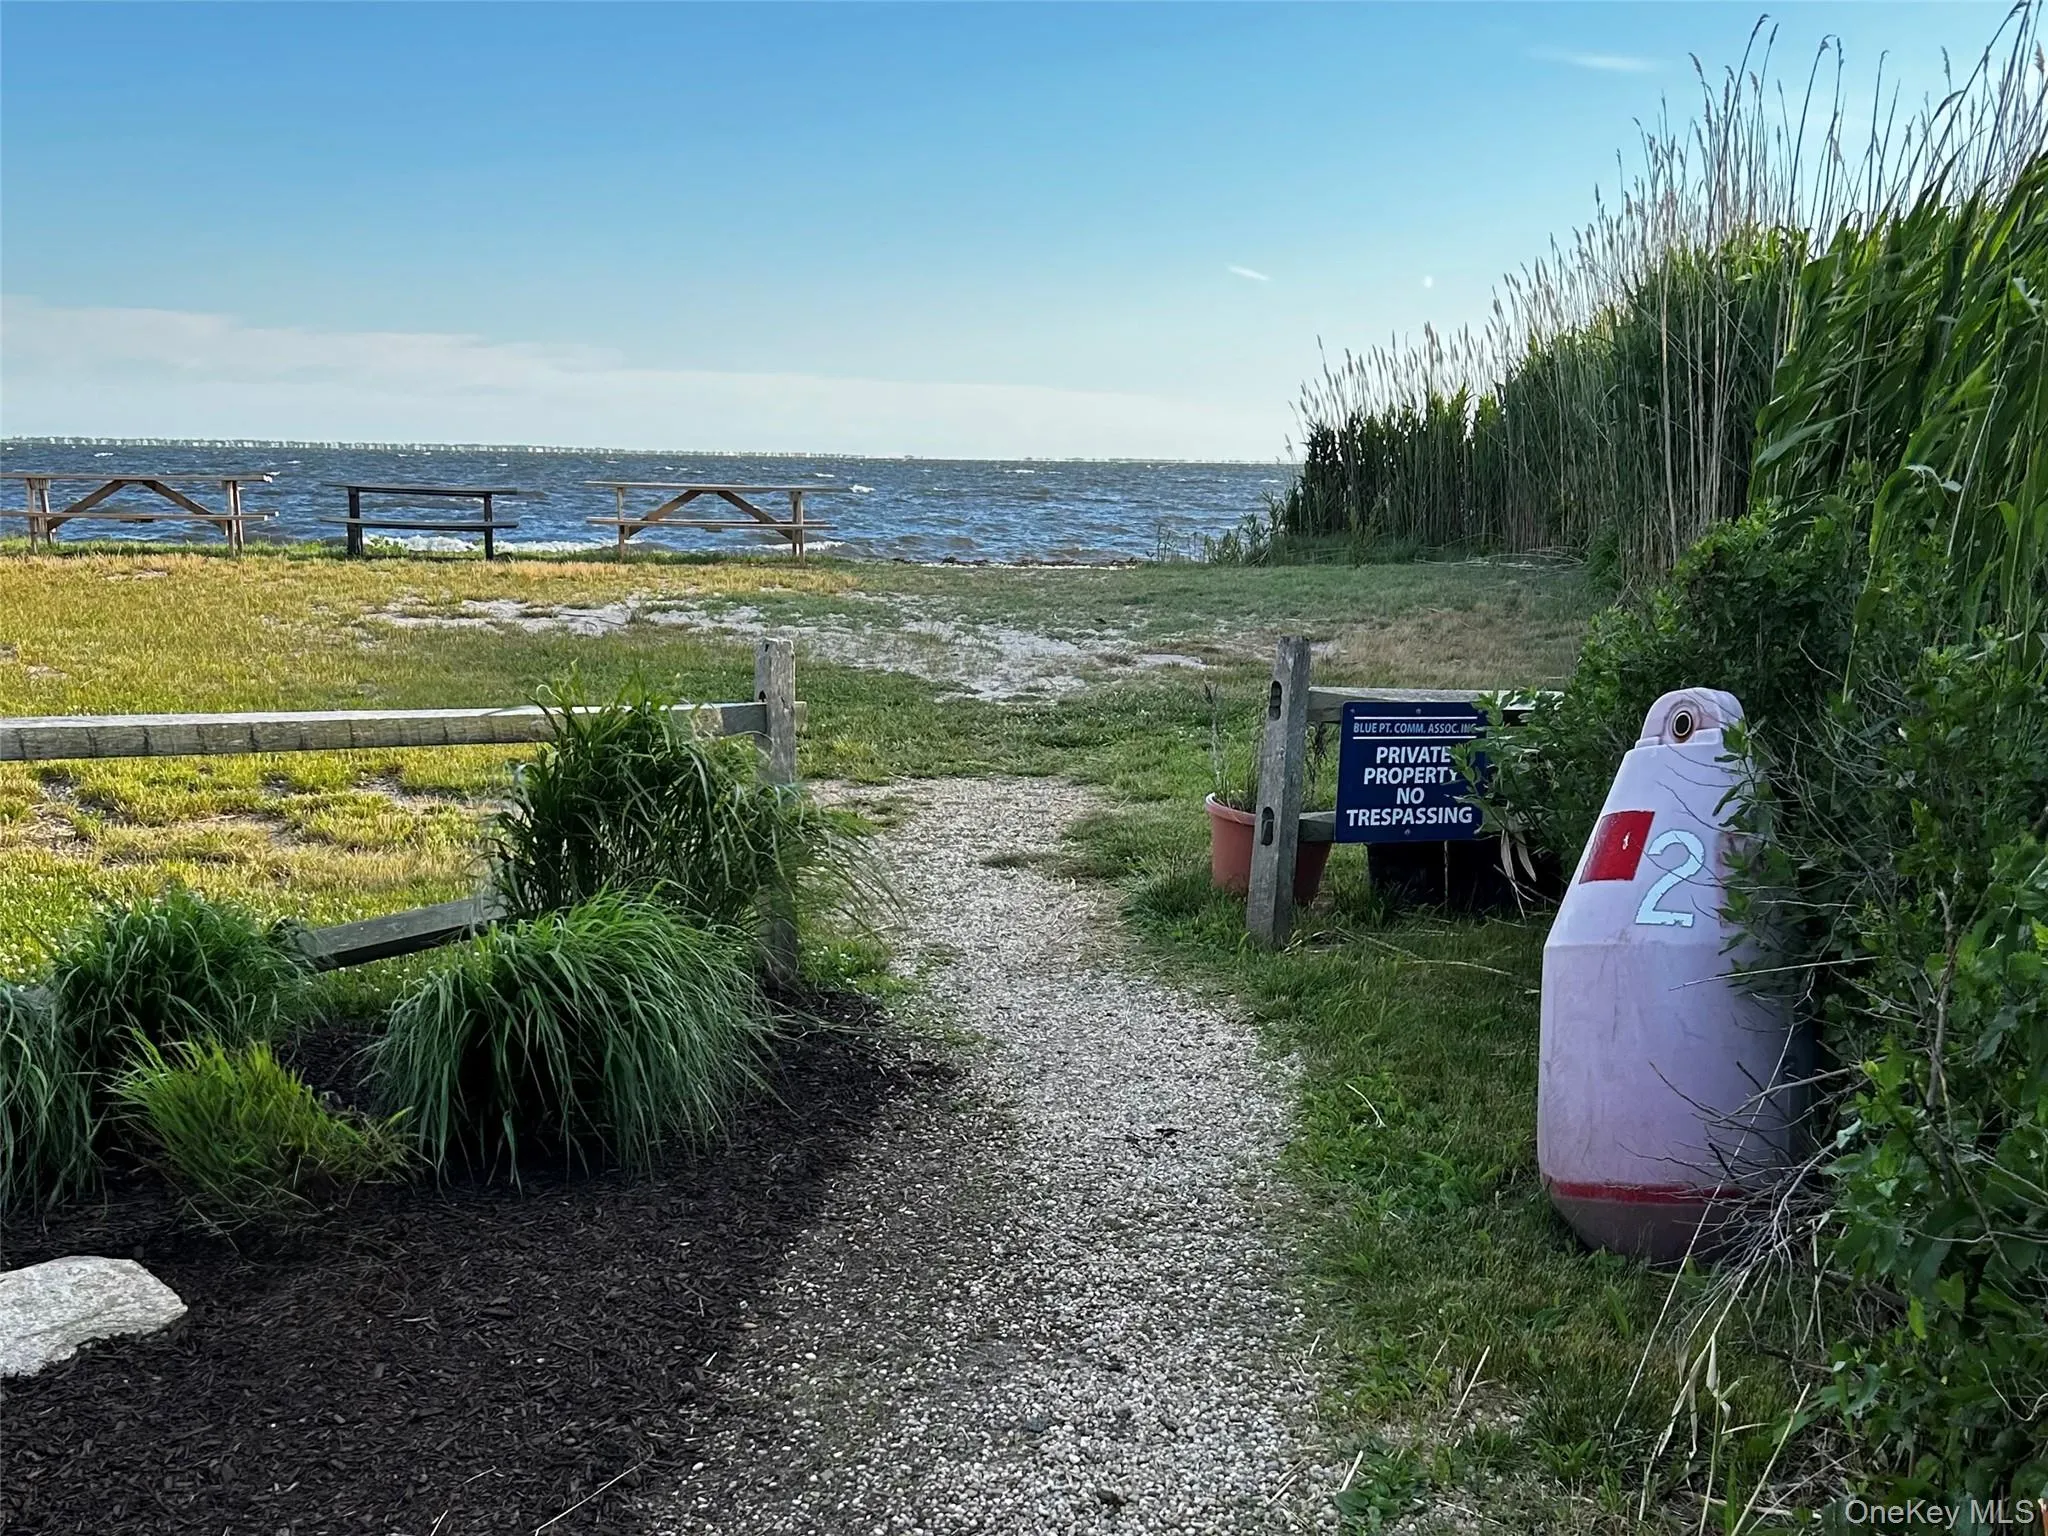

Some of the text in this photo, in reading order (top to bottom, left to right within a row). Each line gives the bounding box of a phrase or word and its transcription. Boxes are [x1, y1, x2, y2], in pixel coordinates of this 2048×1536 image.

[1353, 722, 1377, 734] BLUE
[1379, 723, 1393, 734] PT.
[1394, 723, 1426, 734] COMM.
[1428, 723, 1460, 734] ASSOC.
[1376, 746, 1451, 764] PRIVATE
[1363, 767, 1458, 785] PROPERTY
[1396, 787, 1425, 805] NO
[1346, 807, 1473, 827] TRESPASSING
[1634, 829, 1706, 928] 2
